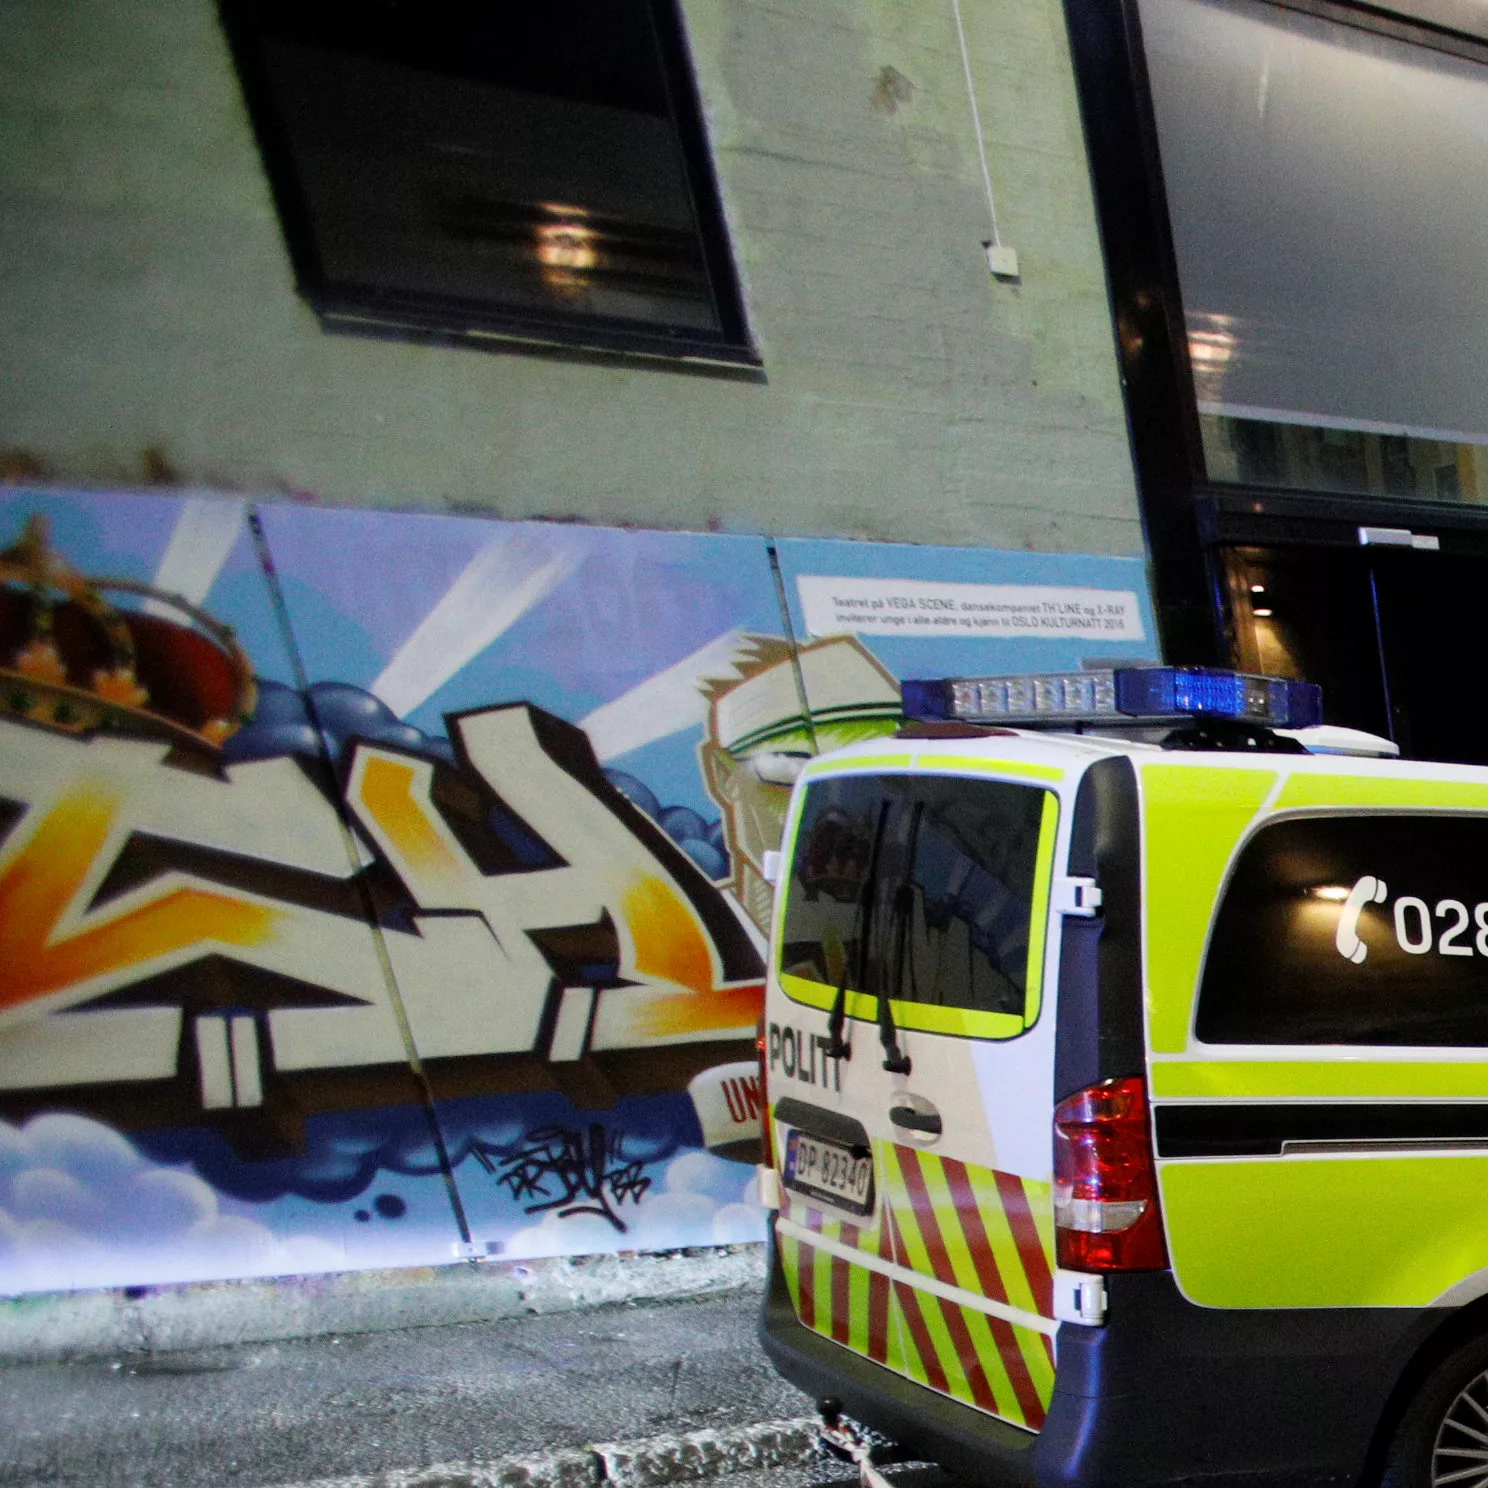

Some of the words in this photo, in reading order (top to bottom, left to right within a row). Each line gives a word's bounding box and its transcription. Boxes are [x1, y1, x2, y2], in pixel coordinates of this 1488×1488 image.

[885, 597, 916, 609] VEGA
[1097, 605, 1126, 616] X-RAY
[1012, 616, 1038, 628] OSLO
[1040, 617, 1101, 629] KULTURNATT
[770, 1022, 842, 1092] POLITI
[797, 1141, 817, 1178] DP
[821, 1149, 869, 1197] 82340
